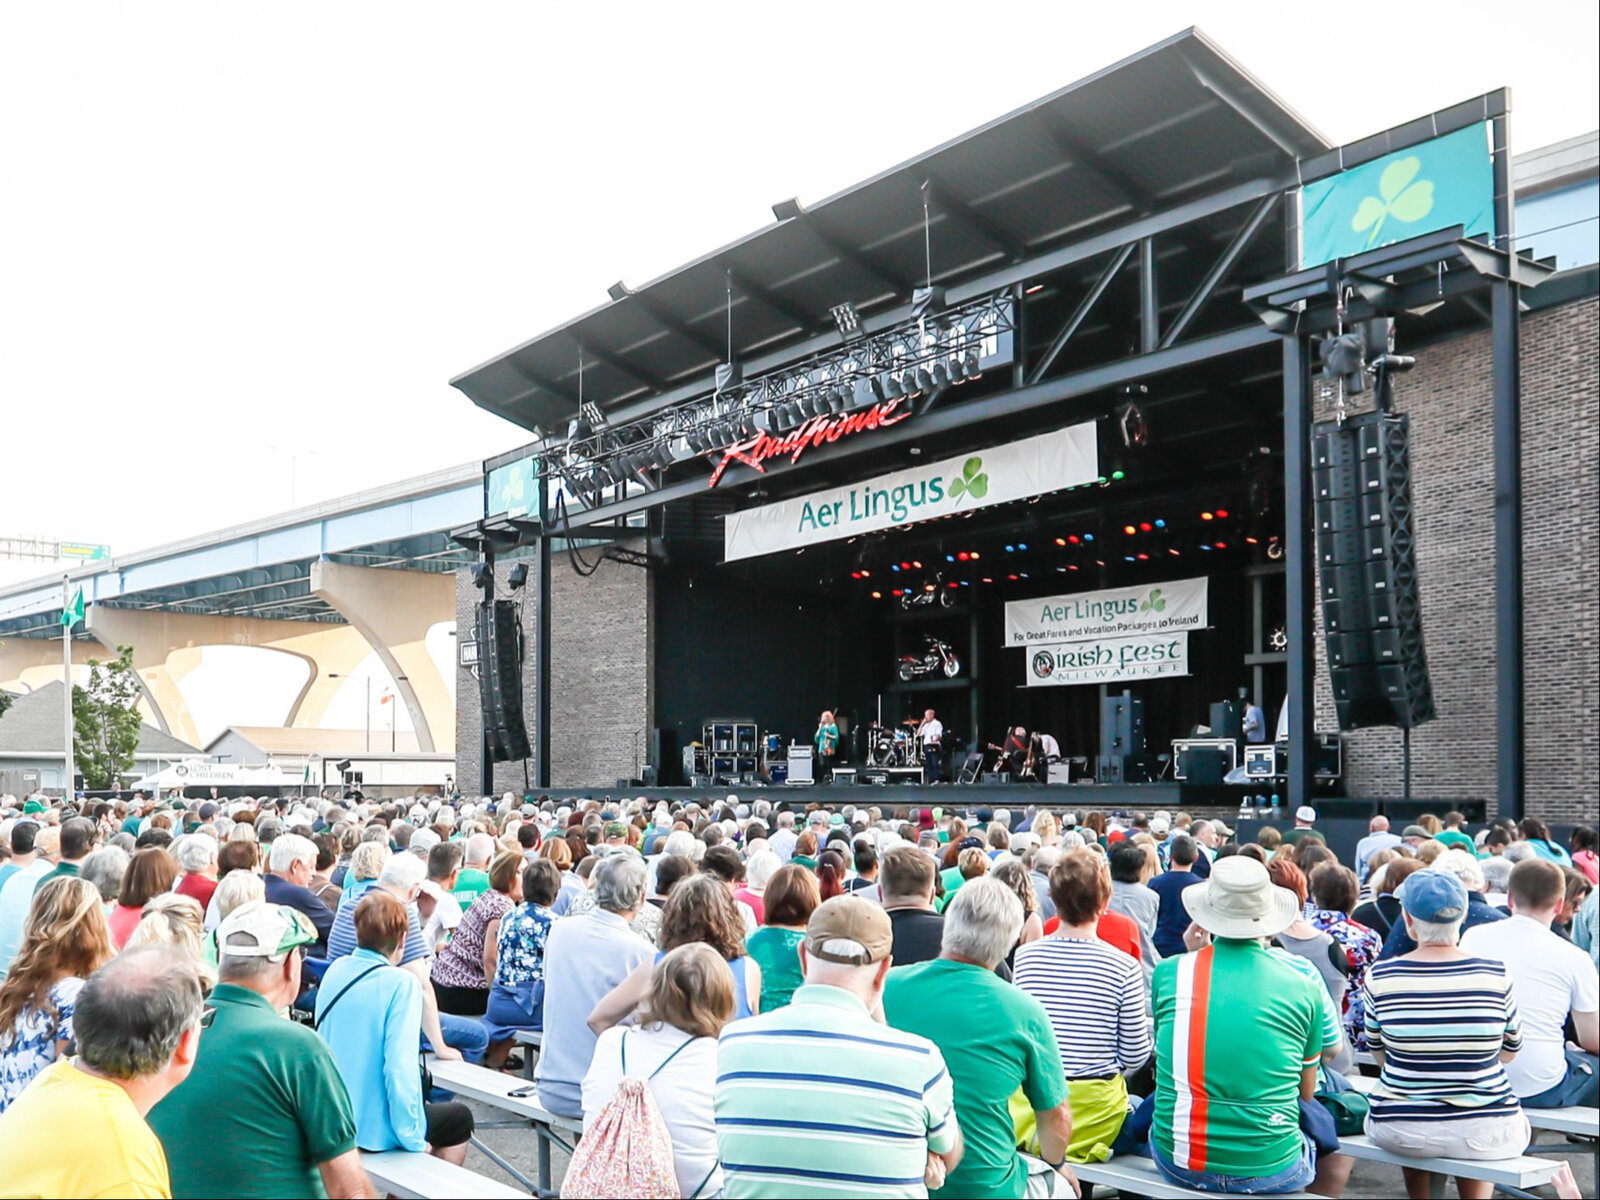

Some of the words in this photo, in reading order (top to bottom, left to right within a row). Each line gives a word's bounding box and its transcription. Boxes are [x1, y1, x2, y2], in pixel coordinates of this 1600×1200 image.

[707, 397, 912, 488] Roadhouse
[798, 501, 843, 533] Aer
[849, 476, 944, 522] Lingus
[1041, 604, 1071, 623] Aer
[1075, 598, 1138, 622] Lingus
[1014, 632, 1025, 641] For
[1026, 630, 1047, 640] Great
[1047, 629, 1067, 639] Fares
[1068, 628, 1082, 637] and
[1084, 624, 1117, 636] Vacation
[1117, 620, 1157, 633] Packages
[1158, 619, 1167, 628] to
[1168, 614, 1199, 627] Ireland
[1057, 664, 1181, 681] MILWAUKEE
[190, 764, 212, 772] LOST
[190, 771, 234, 779] CHILDREN
